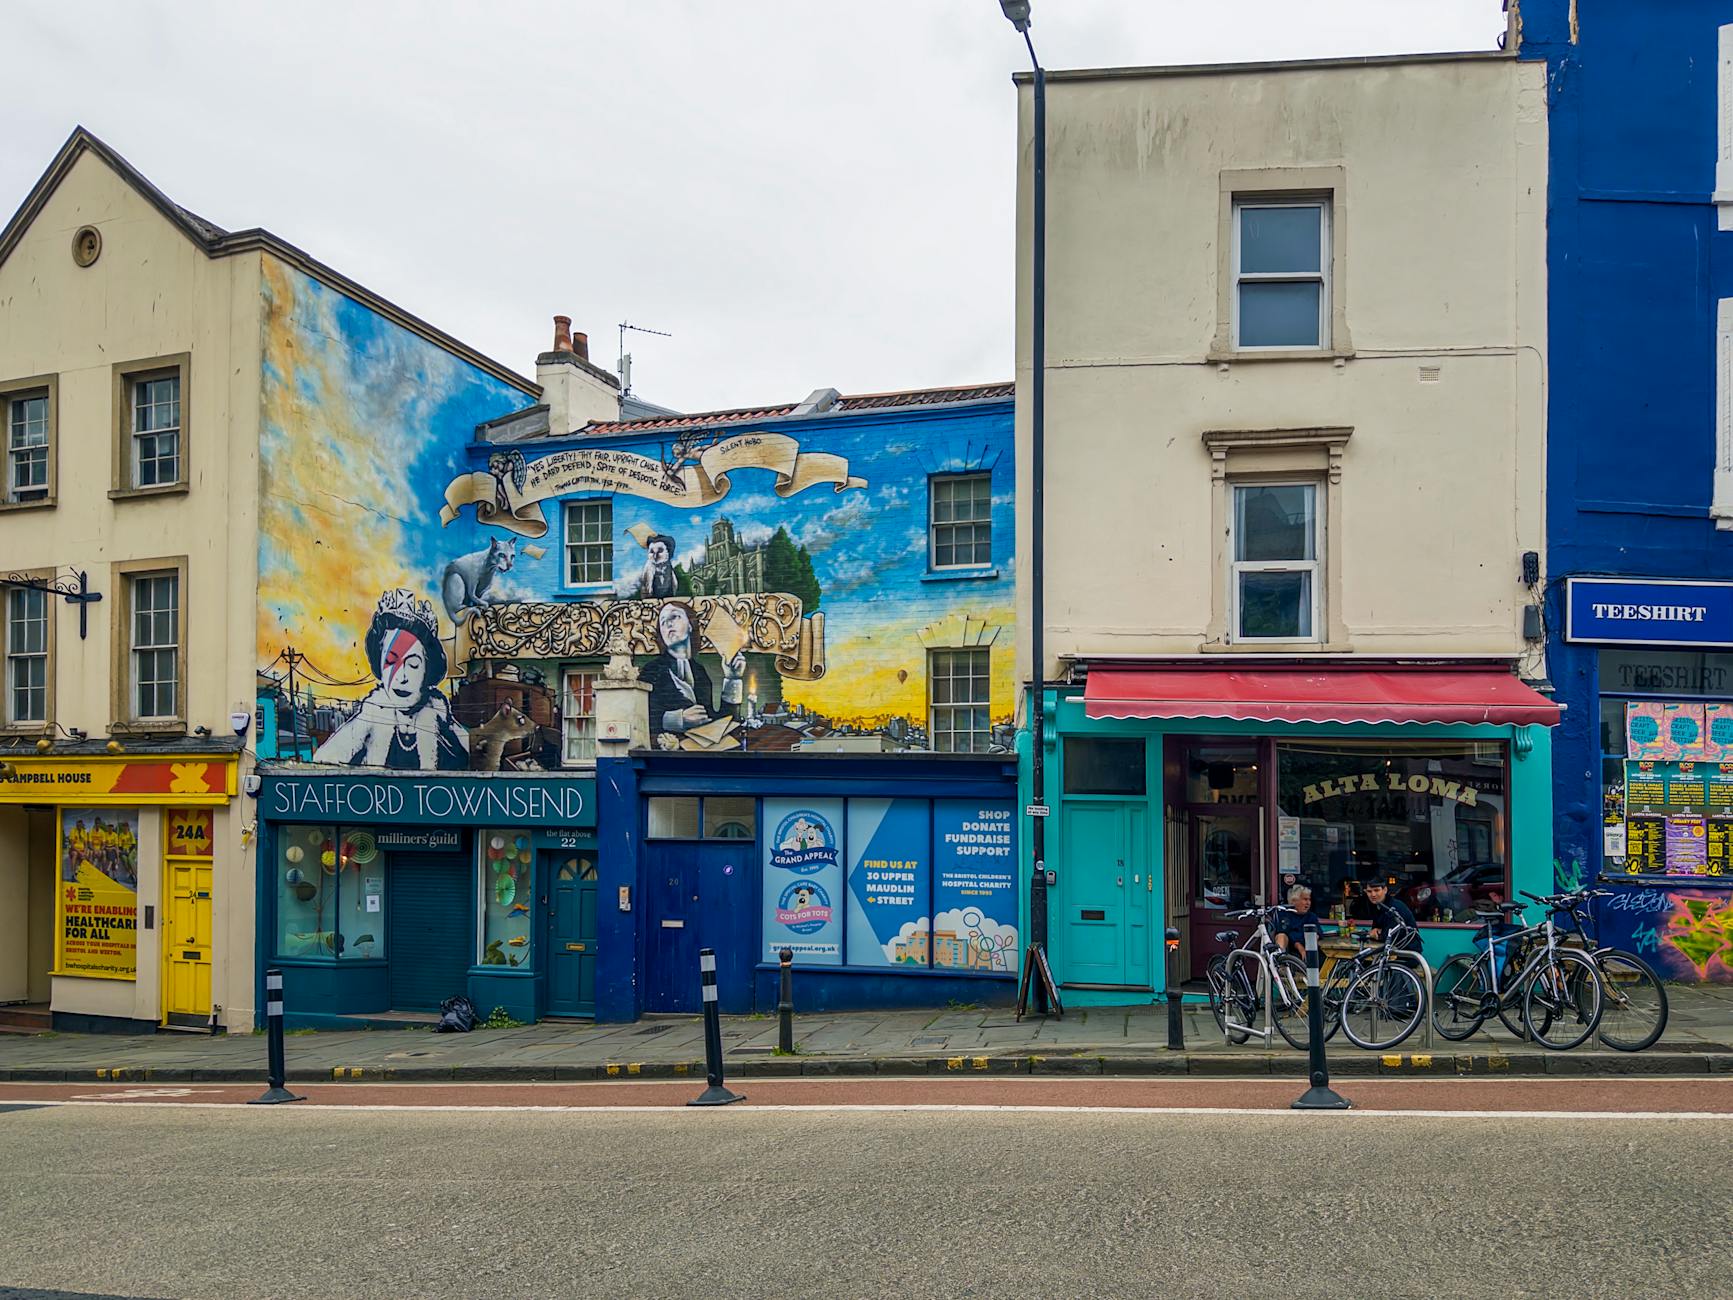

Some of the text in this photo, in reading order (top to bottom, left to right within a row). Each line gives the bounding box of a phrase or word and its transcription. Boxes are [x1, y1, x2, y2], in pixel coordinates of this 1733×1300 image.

[1593, 604, 1706, 621] TEESHIRT
[1618, 664, 1726, 690] TEESHIRT
[58, 774, 91, 784] HOUSE
[1302, 773, 1478, 807] ALTA LOMA
[275, 782, 583, 818] STAFFORD TOWNSEND
[978, 810, 1010, 820] SHOP
[176, 825, 205, 839] 24A
[962, 822, 1010, 832] DONATE
[546, 830, 558, 838] the
[572, 830, 592, 838] above
[945, 834, 1010, 844] FUNDRAISE
[430, 833, 458, 848] guild
[561, 838, 576, 848] 22
[956, 846, 1010, 856] SUPPORT
[775, 852, 833, 864] GRAND APPEAL
[864, 860, 918, 870] FIND US AT
[867, 872, 914, 881] 30 UPPER
[866, 884, 914, 894] MAUDLIN
[1213, 886, 1230, 896] OPEN
[877, 896, 914, 905] STREET
[65, 904, 92, 914] WE'RE
[65, 928, 110, 940] FOR ALL
